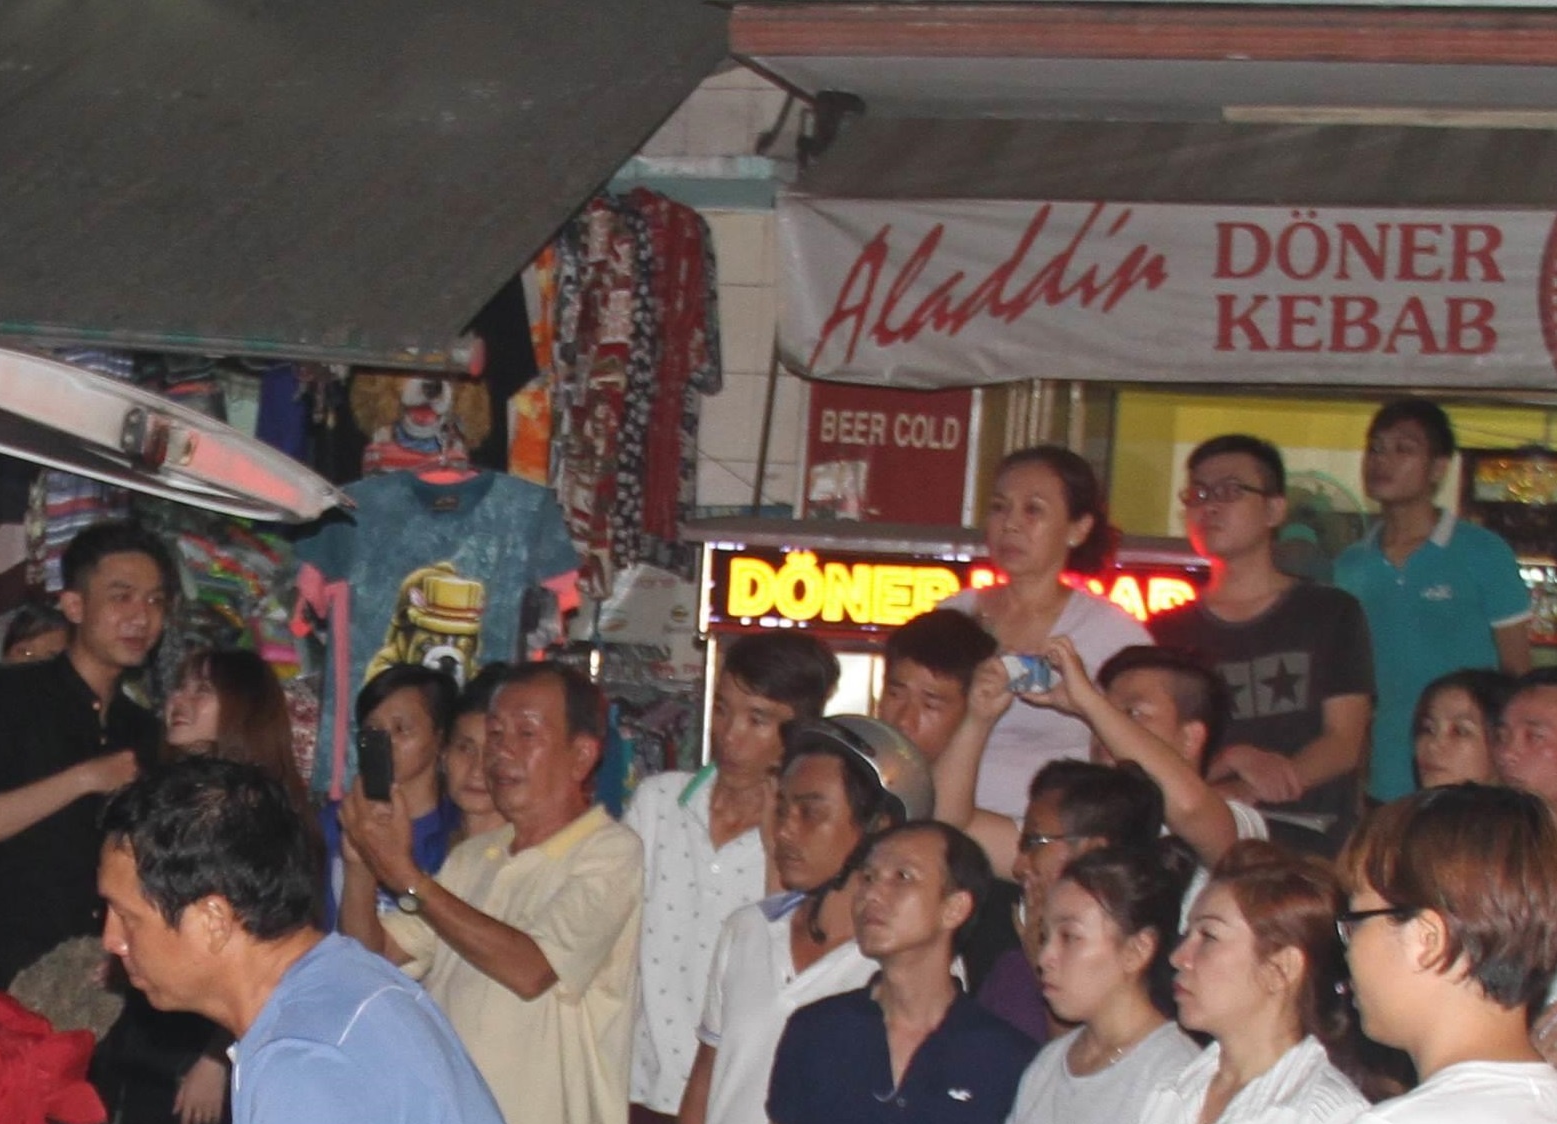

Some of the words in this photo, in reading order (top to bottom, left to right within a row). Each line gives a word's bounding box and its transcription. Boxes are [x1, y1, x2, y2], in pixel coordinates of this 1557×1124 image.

[1212, 210, 1506, 283] DÖNER
[1213, 294, 1499, 356] KEBAB
[820, 409, 886, 446] BEER
[894, 413, 960, 450] COLD
